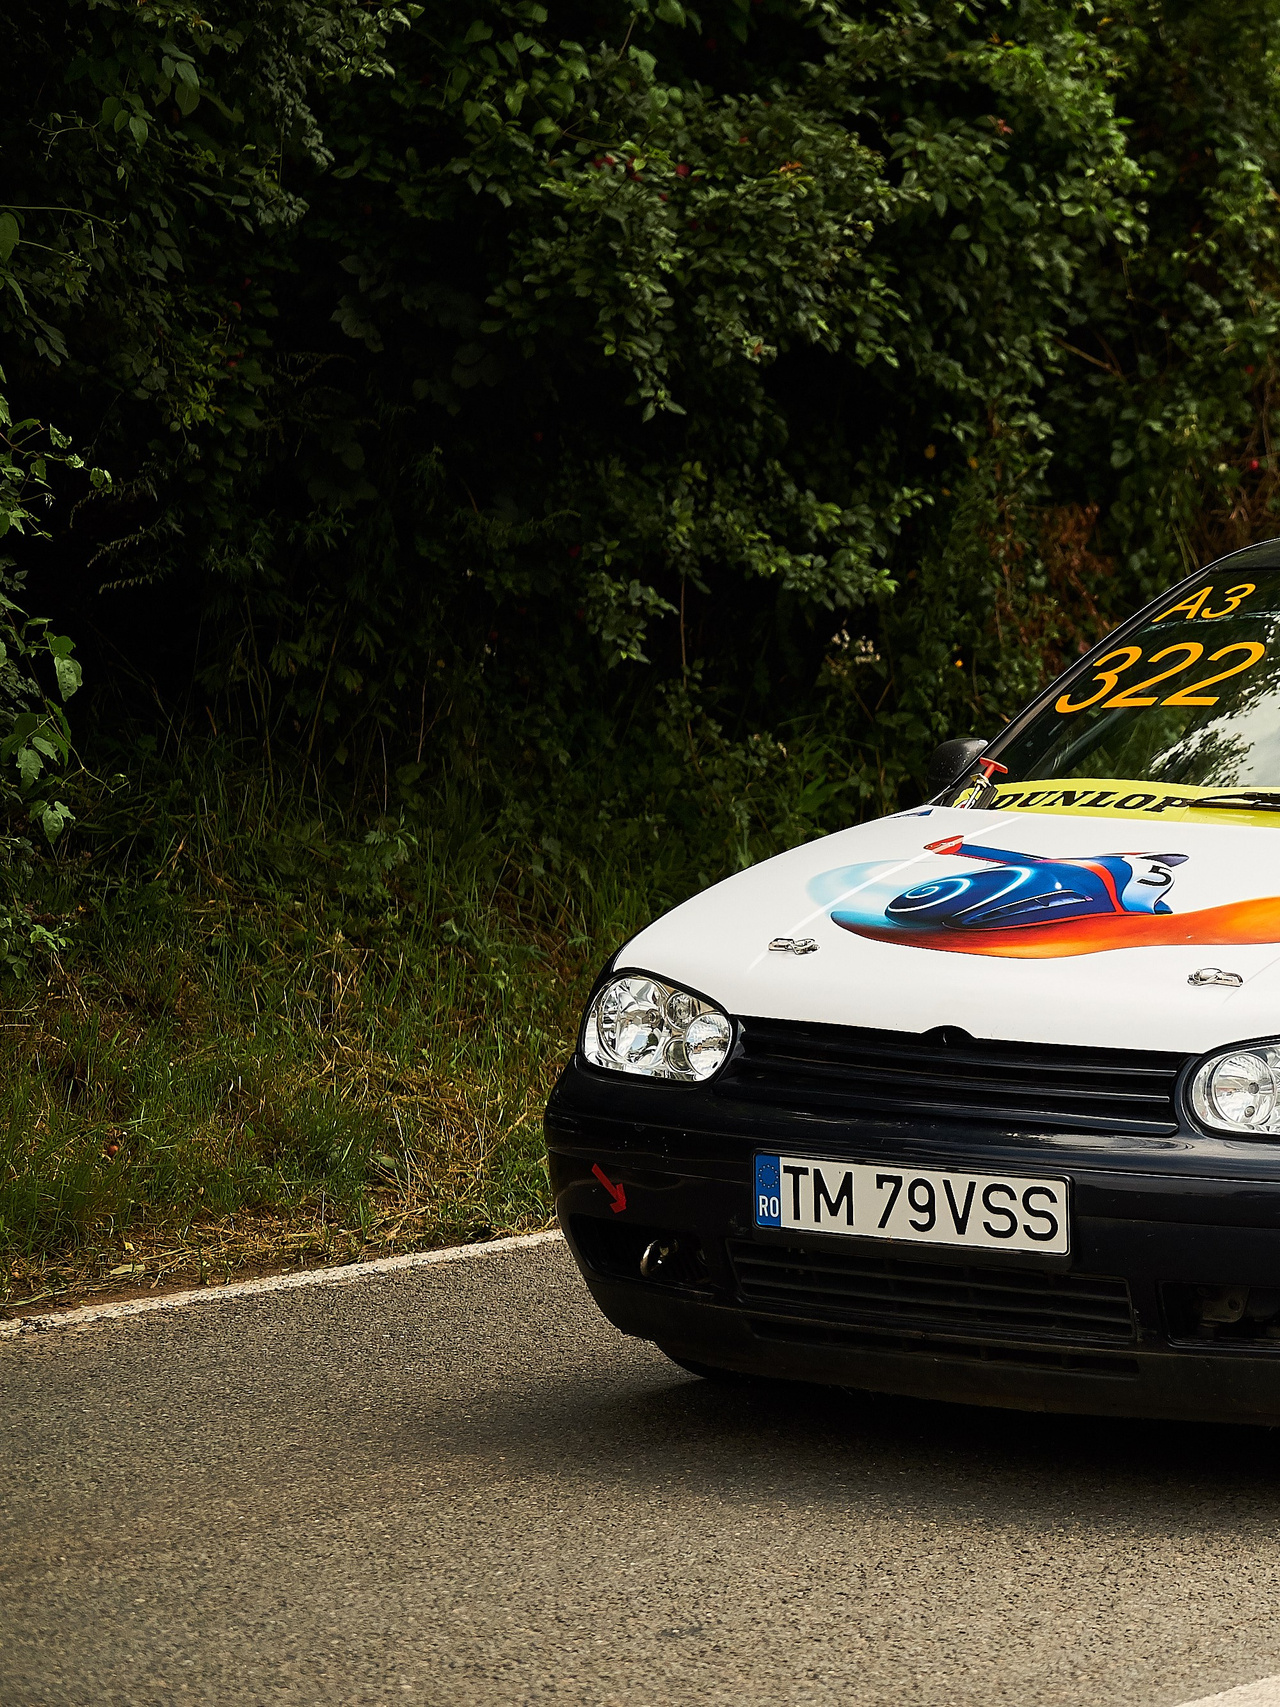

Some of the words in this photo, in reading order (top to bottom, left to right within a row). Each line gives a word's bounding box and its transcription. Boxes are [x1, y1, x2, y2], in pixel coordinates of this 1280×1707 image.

[1151, 583, 1256, 623] A3
[1055, 641, 1266, 714] 322
[990, 790, 1191, 813] DUNLOP
[758, 1195, 780, 1218] RO
[783, 1165, 854, 1226] TM
[876, 1173, 1059, 1242] 79VSS
